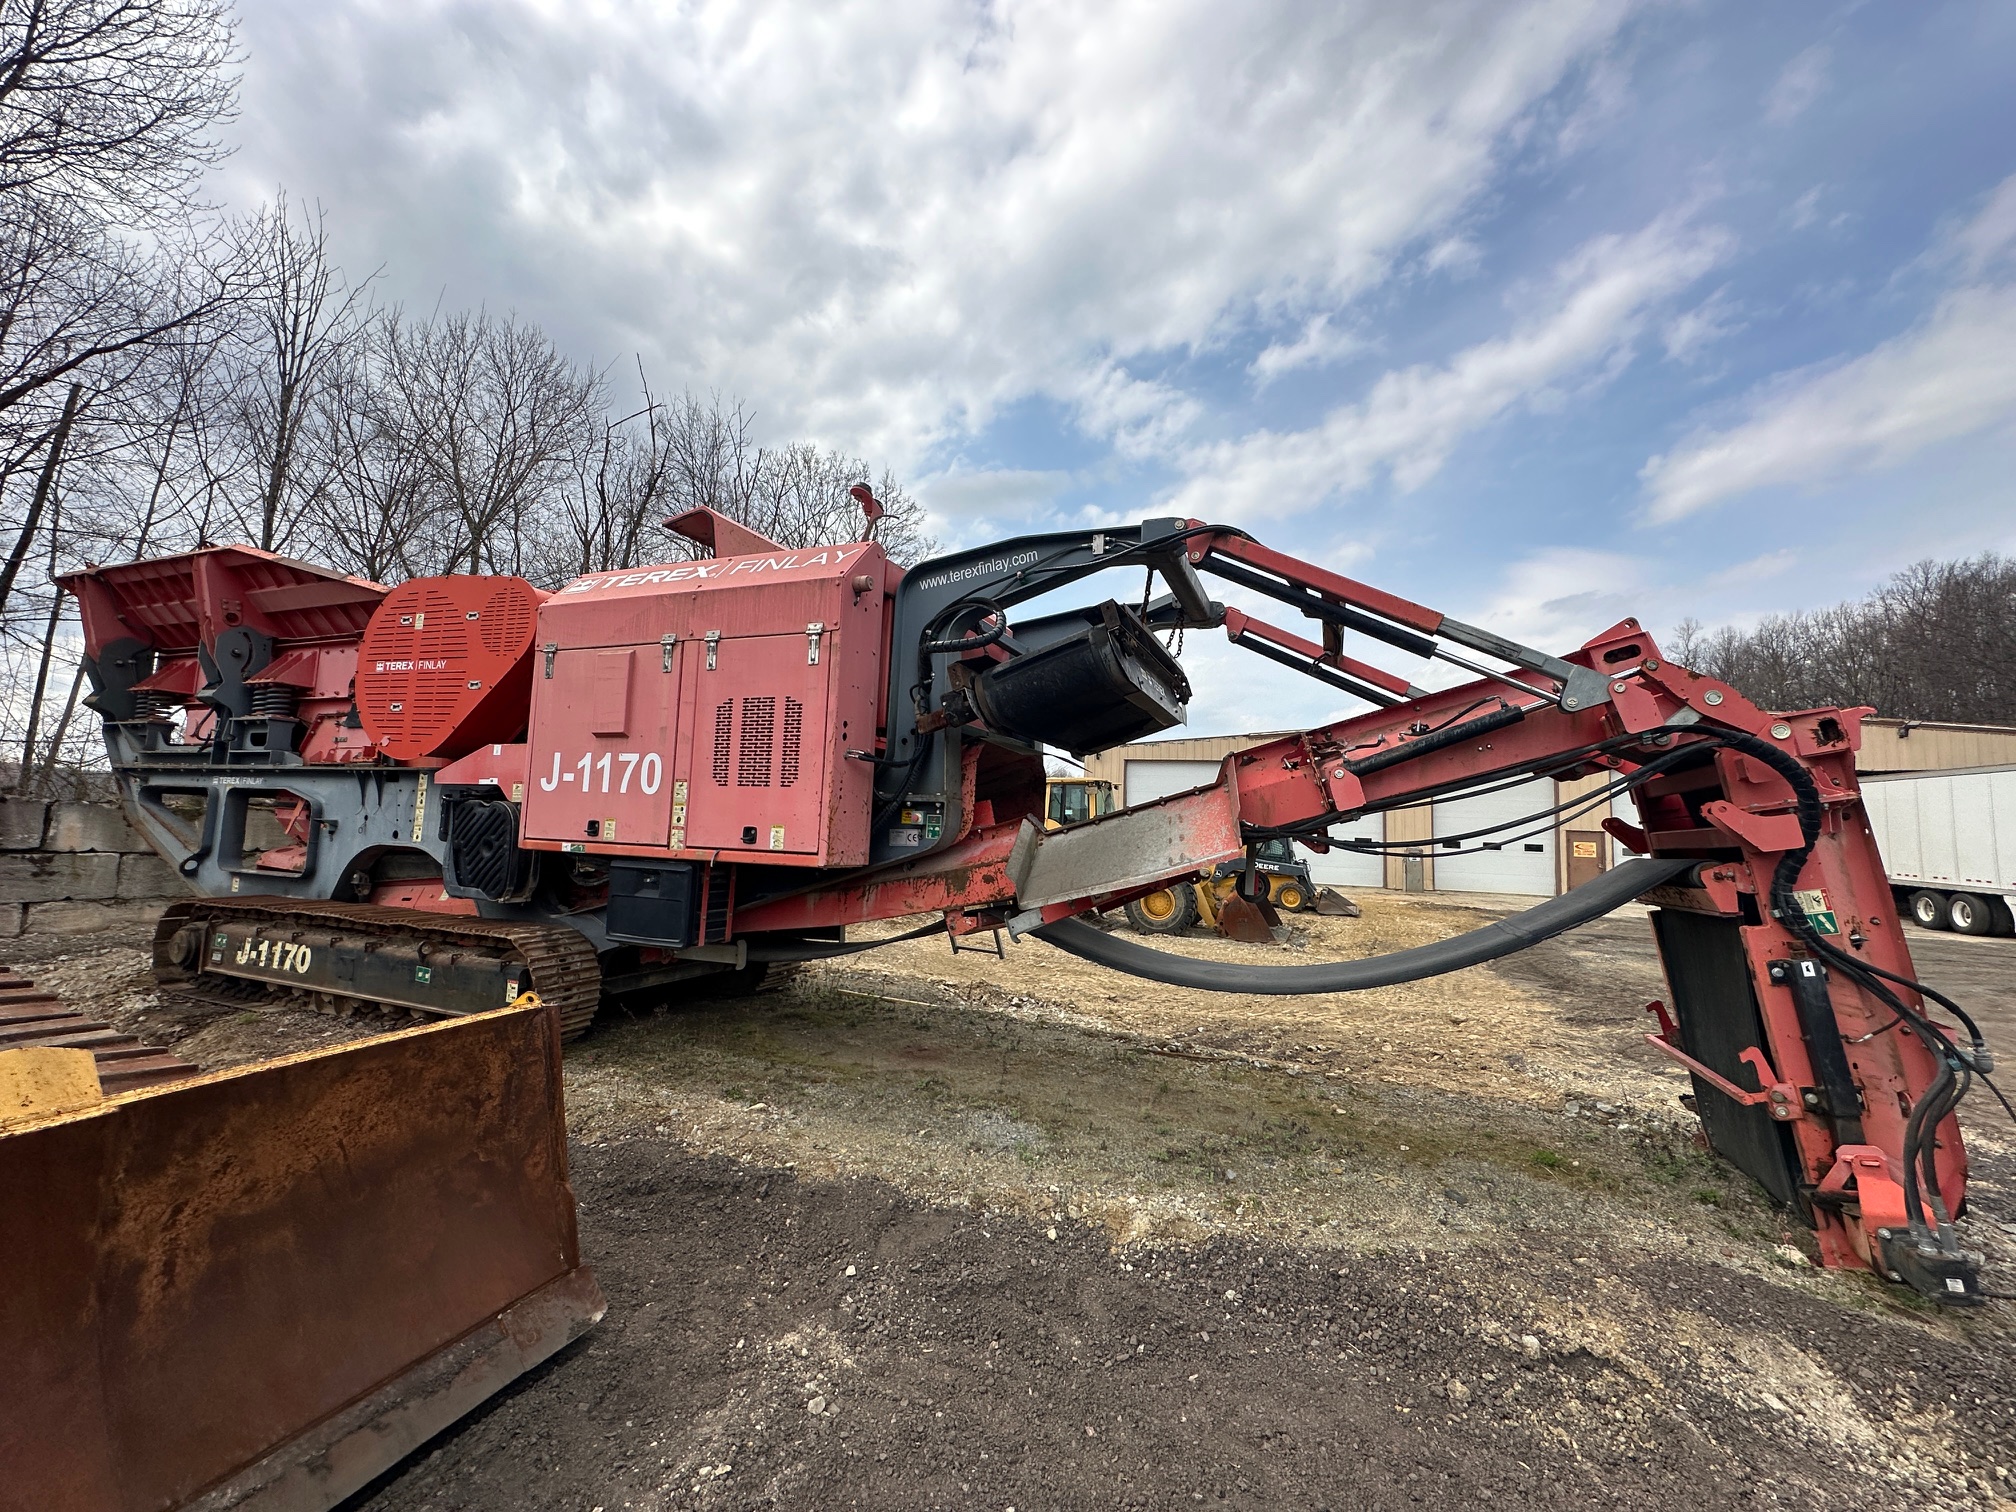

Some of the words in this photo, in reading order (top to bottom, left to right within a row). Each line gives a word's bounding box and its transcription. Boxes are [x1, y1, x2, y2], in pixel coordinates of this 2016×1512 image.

[600, 563, 720, 590] TEREX
[729, 548, 861, 576] FINLAY
[919, 550, 1039, 590] www.terexfinlay.com
[385, 660, 415, 671] TEREX
[418, 659, 447, 670] FINLAY
[219, 776, 241, 785] TEREX
[242, 777, 264, 785] FINLAY
[540, 752, 663, 795] J-1170
[236, 937, 312, 974] J-1170
